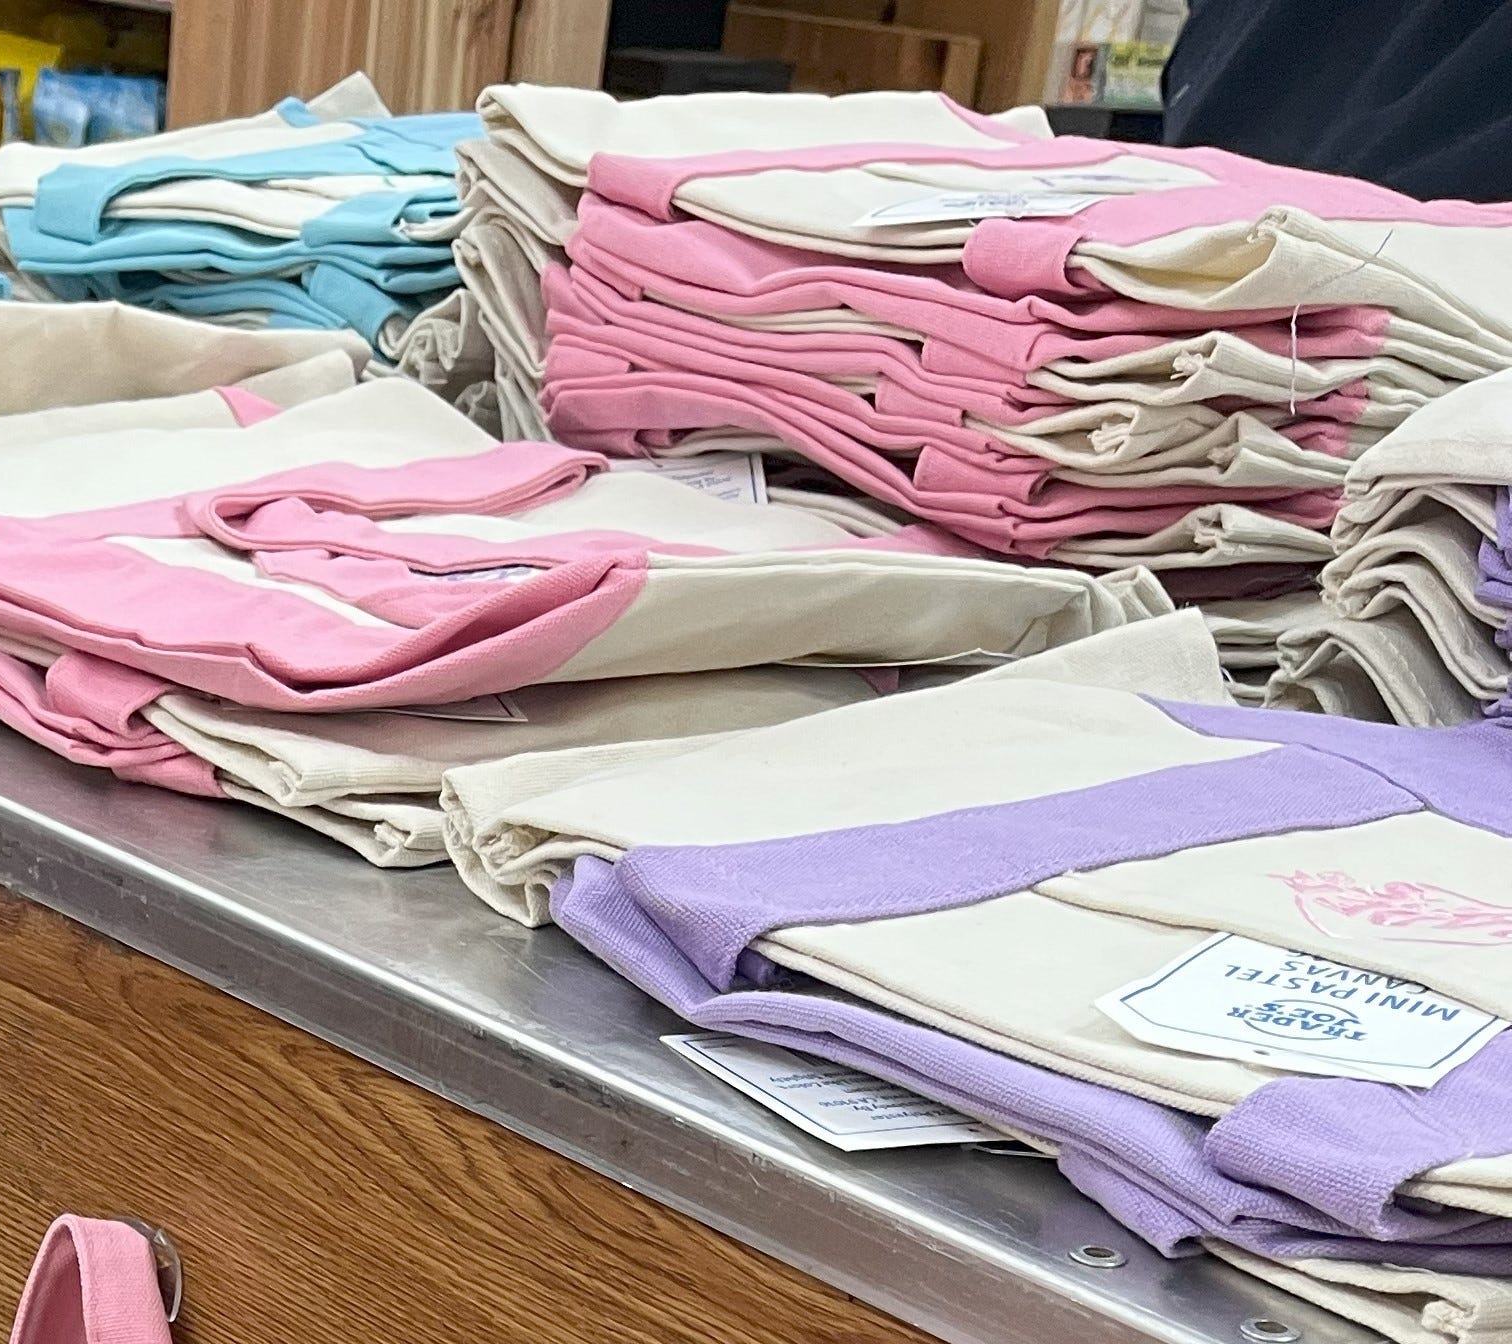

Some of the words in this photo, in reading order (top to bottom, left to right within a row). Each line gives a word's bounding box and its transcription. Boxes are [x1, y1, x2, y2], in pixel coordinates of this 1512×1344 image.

[1223, 963, 1359, 1000] PASTEL
[1256, 1002, 1363, 1026] JOE'S
[1364, 991, 1462, 1022] MINI
[1226, 1006, 1369, 1042] TRADER
